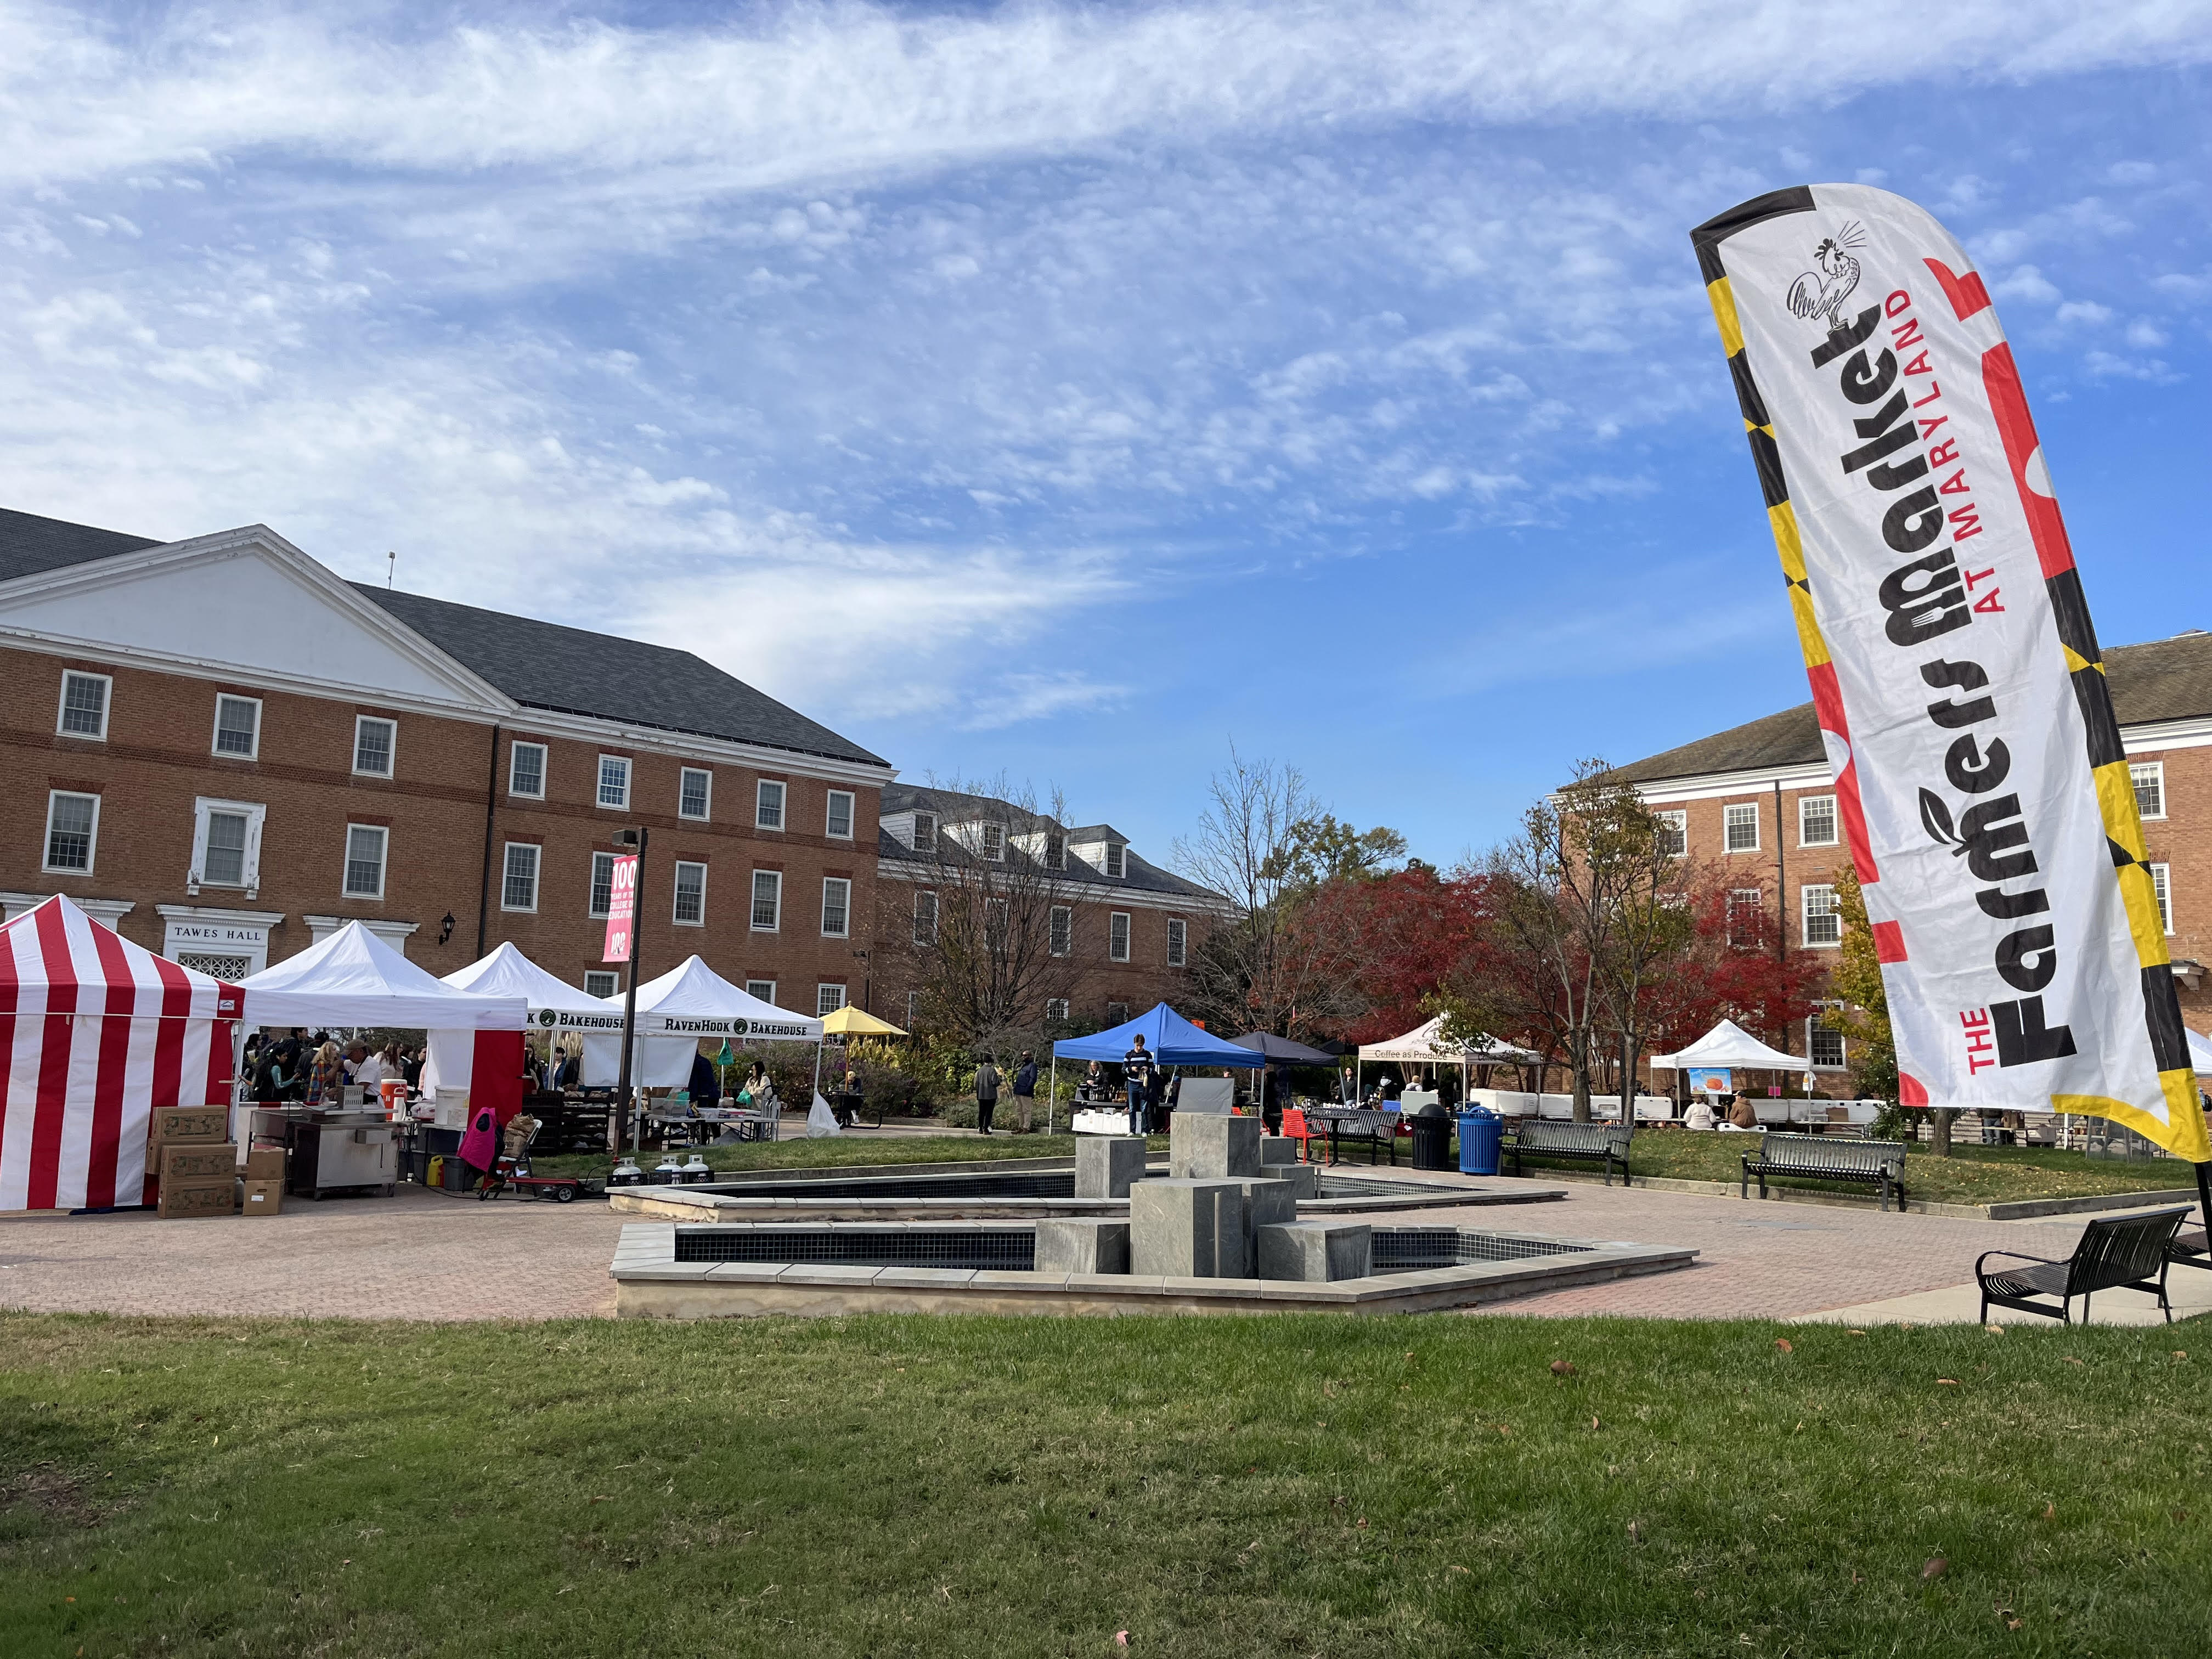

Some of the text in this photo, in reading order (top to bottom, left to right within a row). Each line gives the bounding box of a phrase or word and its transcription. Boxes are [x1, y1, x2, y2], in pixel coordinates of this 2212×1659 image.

[1885, 290, 2005, 613] AT MARYLAND
[1920, 658, 2078, 1068] Farmers
[613, 860, 637, 890] 100
[610, 900, 628, 910] COLLEGE
[175, 927, 261, 940] TAWES HALL
[751, 1022, 807, 1036] BAKEHOUSE
[1960, 1008, 1995, 1076] THE
[1414, 1051, 1447, 1060] Produce
